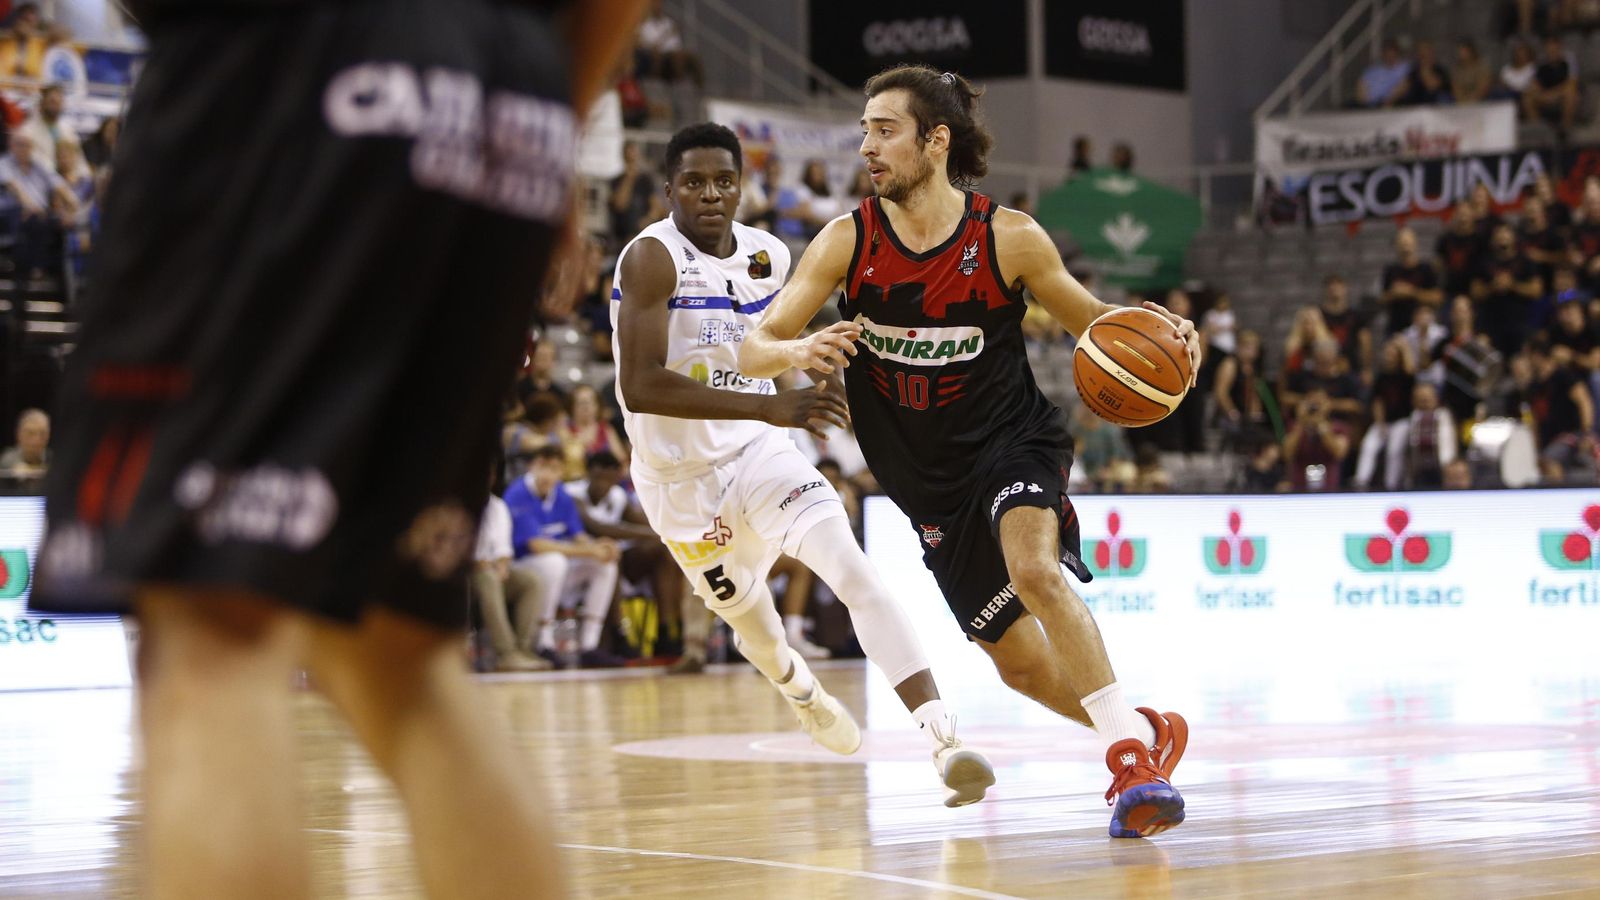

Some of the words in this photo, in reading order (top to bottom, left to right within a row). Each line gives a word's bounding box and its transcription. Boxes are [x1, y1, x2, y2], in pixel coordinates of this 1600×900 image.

[1309, 152, 1547, 225] ESQUINA
[895, 371, 930, 411] 10
[1097, 390, 1123, 411] FIBA
[703, 564, 736, 601] 5
[1333, 577, 1465, 606] fertisac
